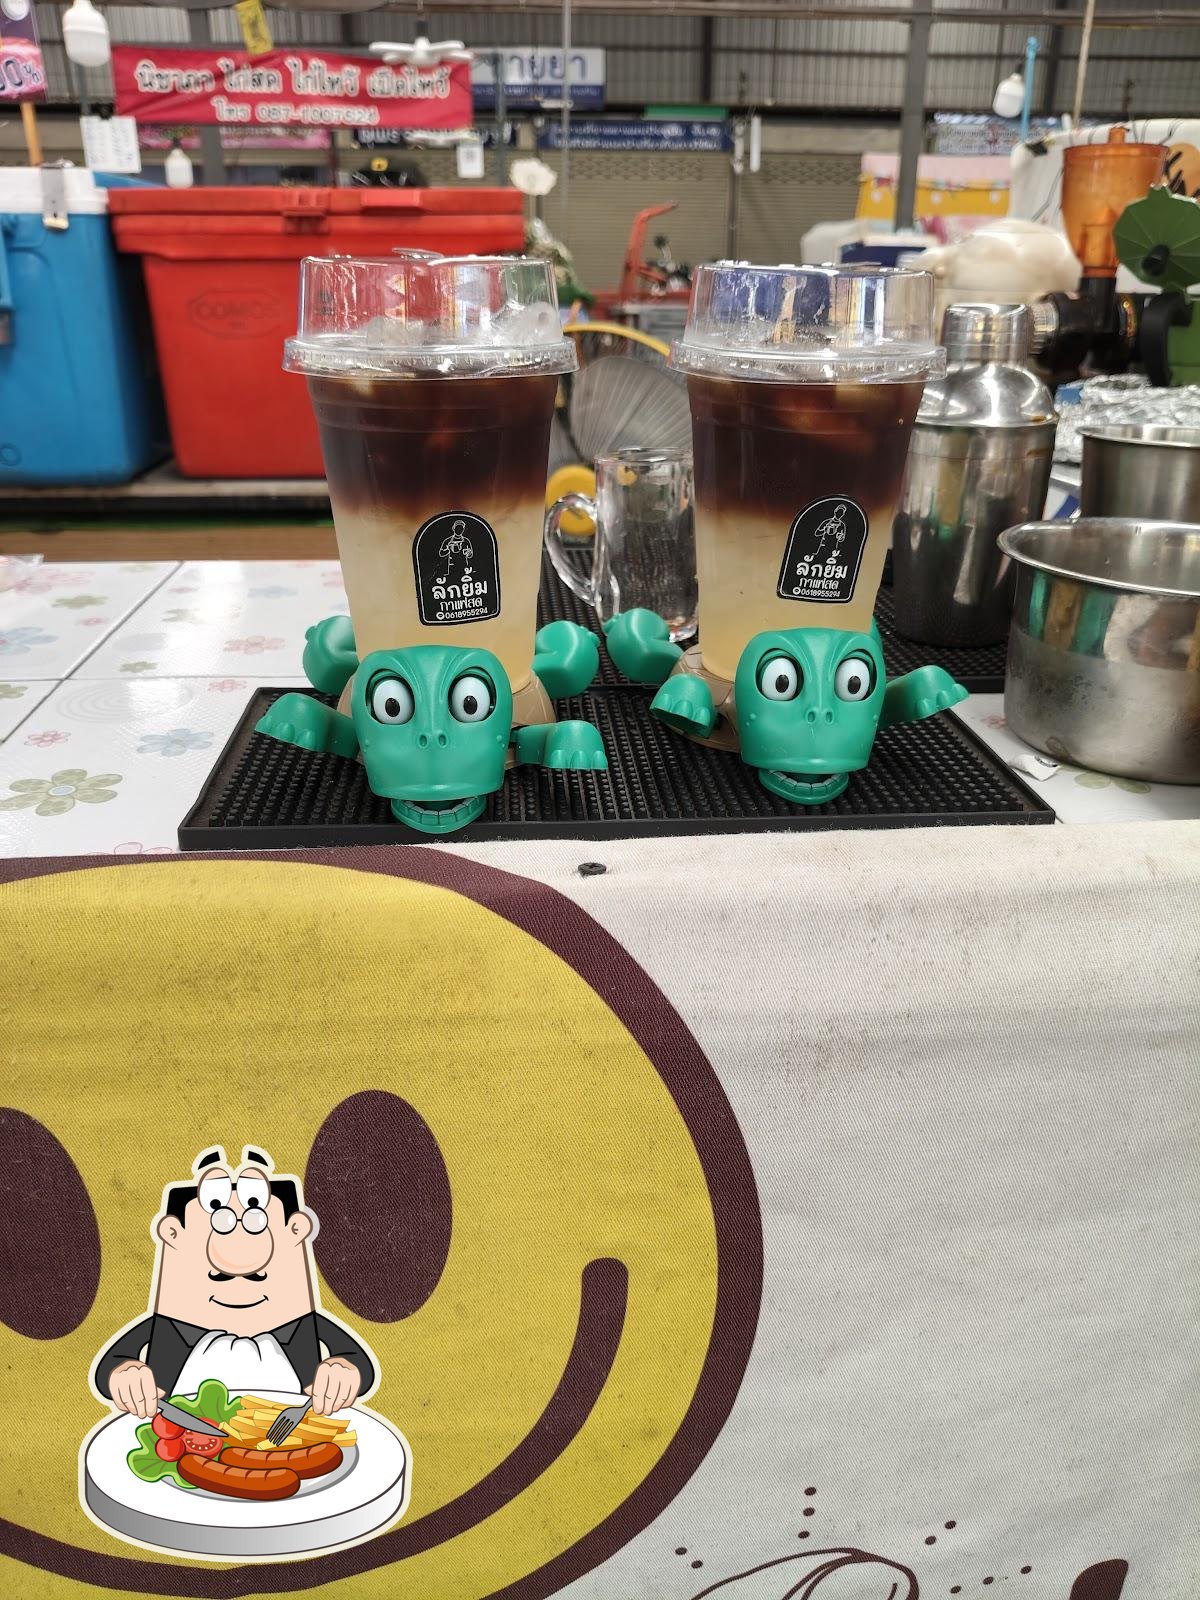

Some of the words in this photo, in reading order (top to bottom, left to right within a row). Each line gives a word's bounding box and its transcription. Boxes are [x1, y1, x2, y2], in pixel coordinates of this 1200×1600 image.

[217, 58, 283, 92] ไก่สด
[796, 550, 848, 578] ลักยิ้ม
[432, 567, 487, 599] ลักยิ้ม
[799, 578, 839, 589] กาแฟสด
[440, 597, 482, 611] กาแฟสด
